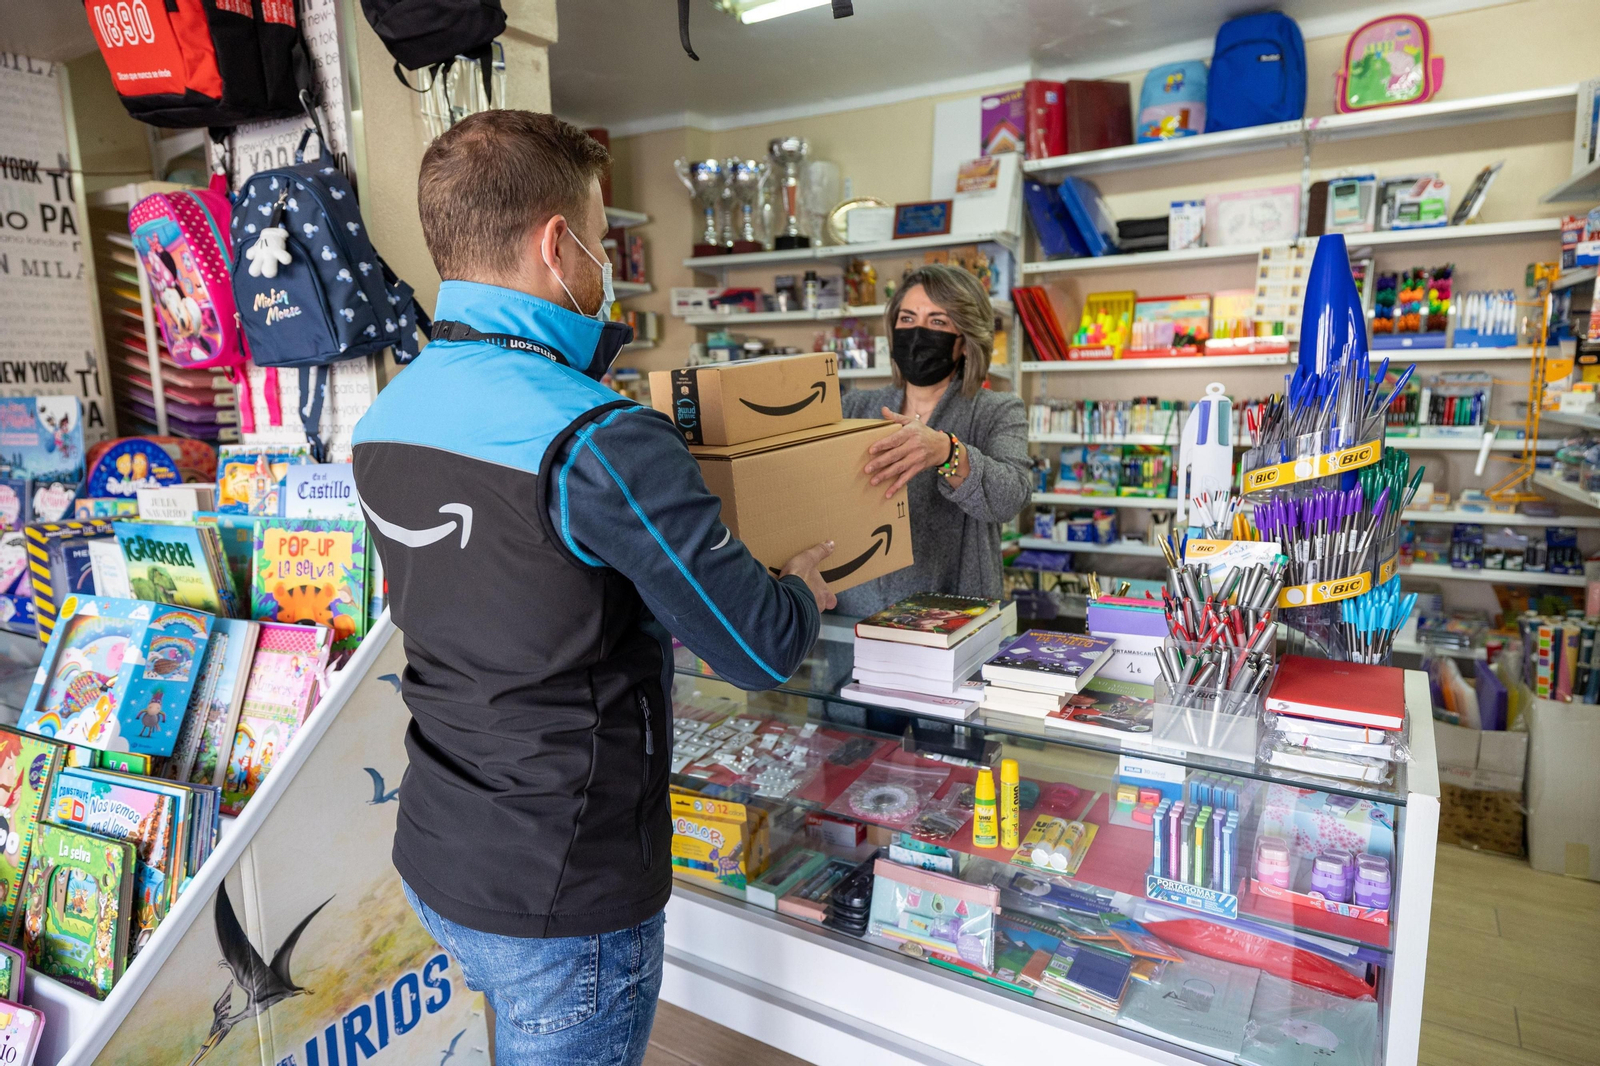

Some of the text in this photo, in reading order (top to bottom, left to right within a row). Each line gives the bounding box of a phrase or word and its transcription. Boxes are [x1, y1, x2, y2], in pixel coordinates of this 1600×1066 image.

[94, 0, 155, 48] 1890
[253, 288, 290, 312] Mickey
[265, 305, 303, 326] Mouse
[523, 337, 557, 362] amazon
[29, 360, 71, 383] YORK
[297, 480, 351, 499] Castillo
[278, 535, 335, 557] POP-UP
[58, 786, 89, 804] CONSTRUYE
[57, 797, 85, 823] 3D
[90, 799, 141, 825] Nos vemos
[717, 803, 729, 815] 12
[58, 839, 92, 864] La selva
[1156, 878, 1217, 900] PORTAGOMAS
